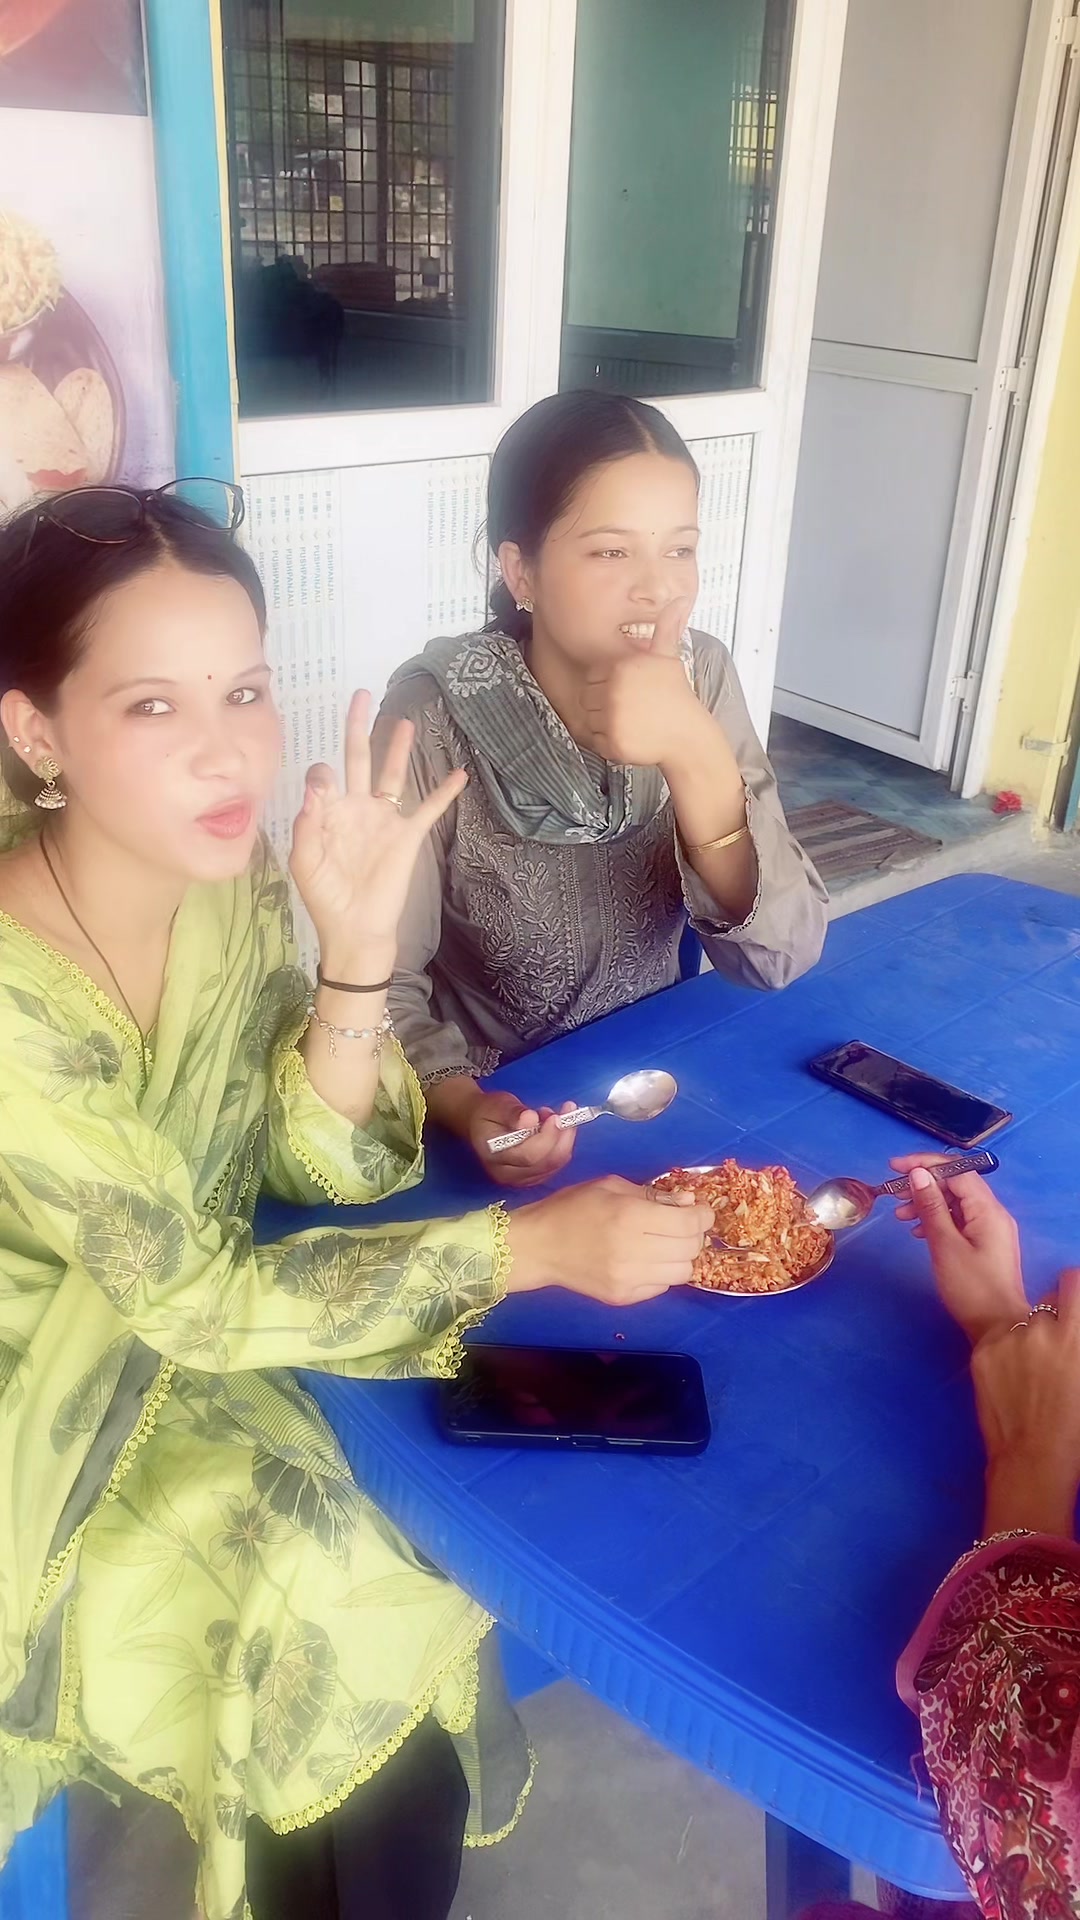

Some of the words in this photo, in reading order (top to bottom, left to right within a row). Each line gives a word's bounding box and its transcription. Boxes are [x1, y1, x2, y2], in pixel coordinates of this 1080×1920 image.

[271, 550, 280, 609] PUSHPANJALI
[285, 548, 294, 608] PUSHPANJALI
[299, 546, 307, 606] PUSHPANJALI
[313, 545, 321, 603] PUSHPANJALI
[326, 543, 334, 601] PUSHPANJALI
